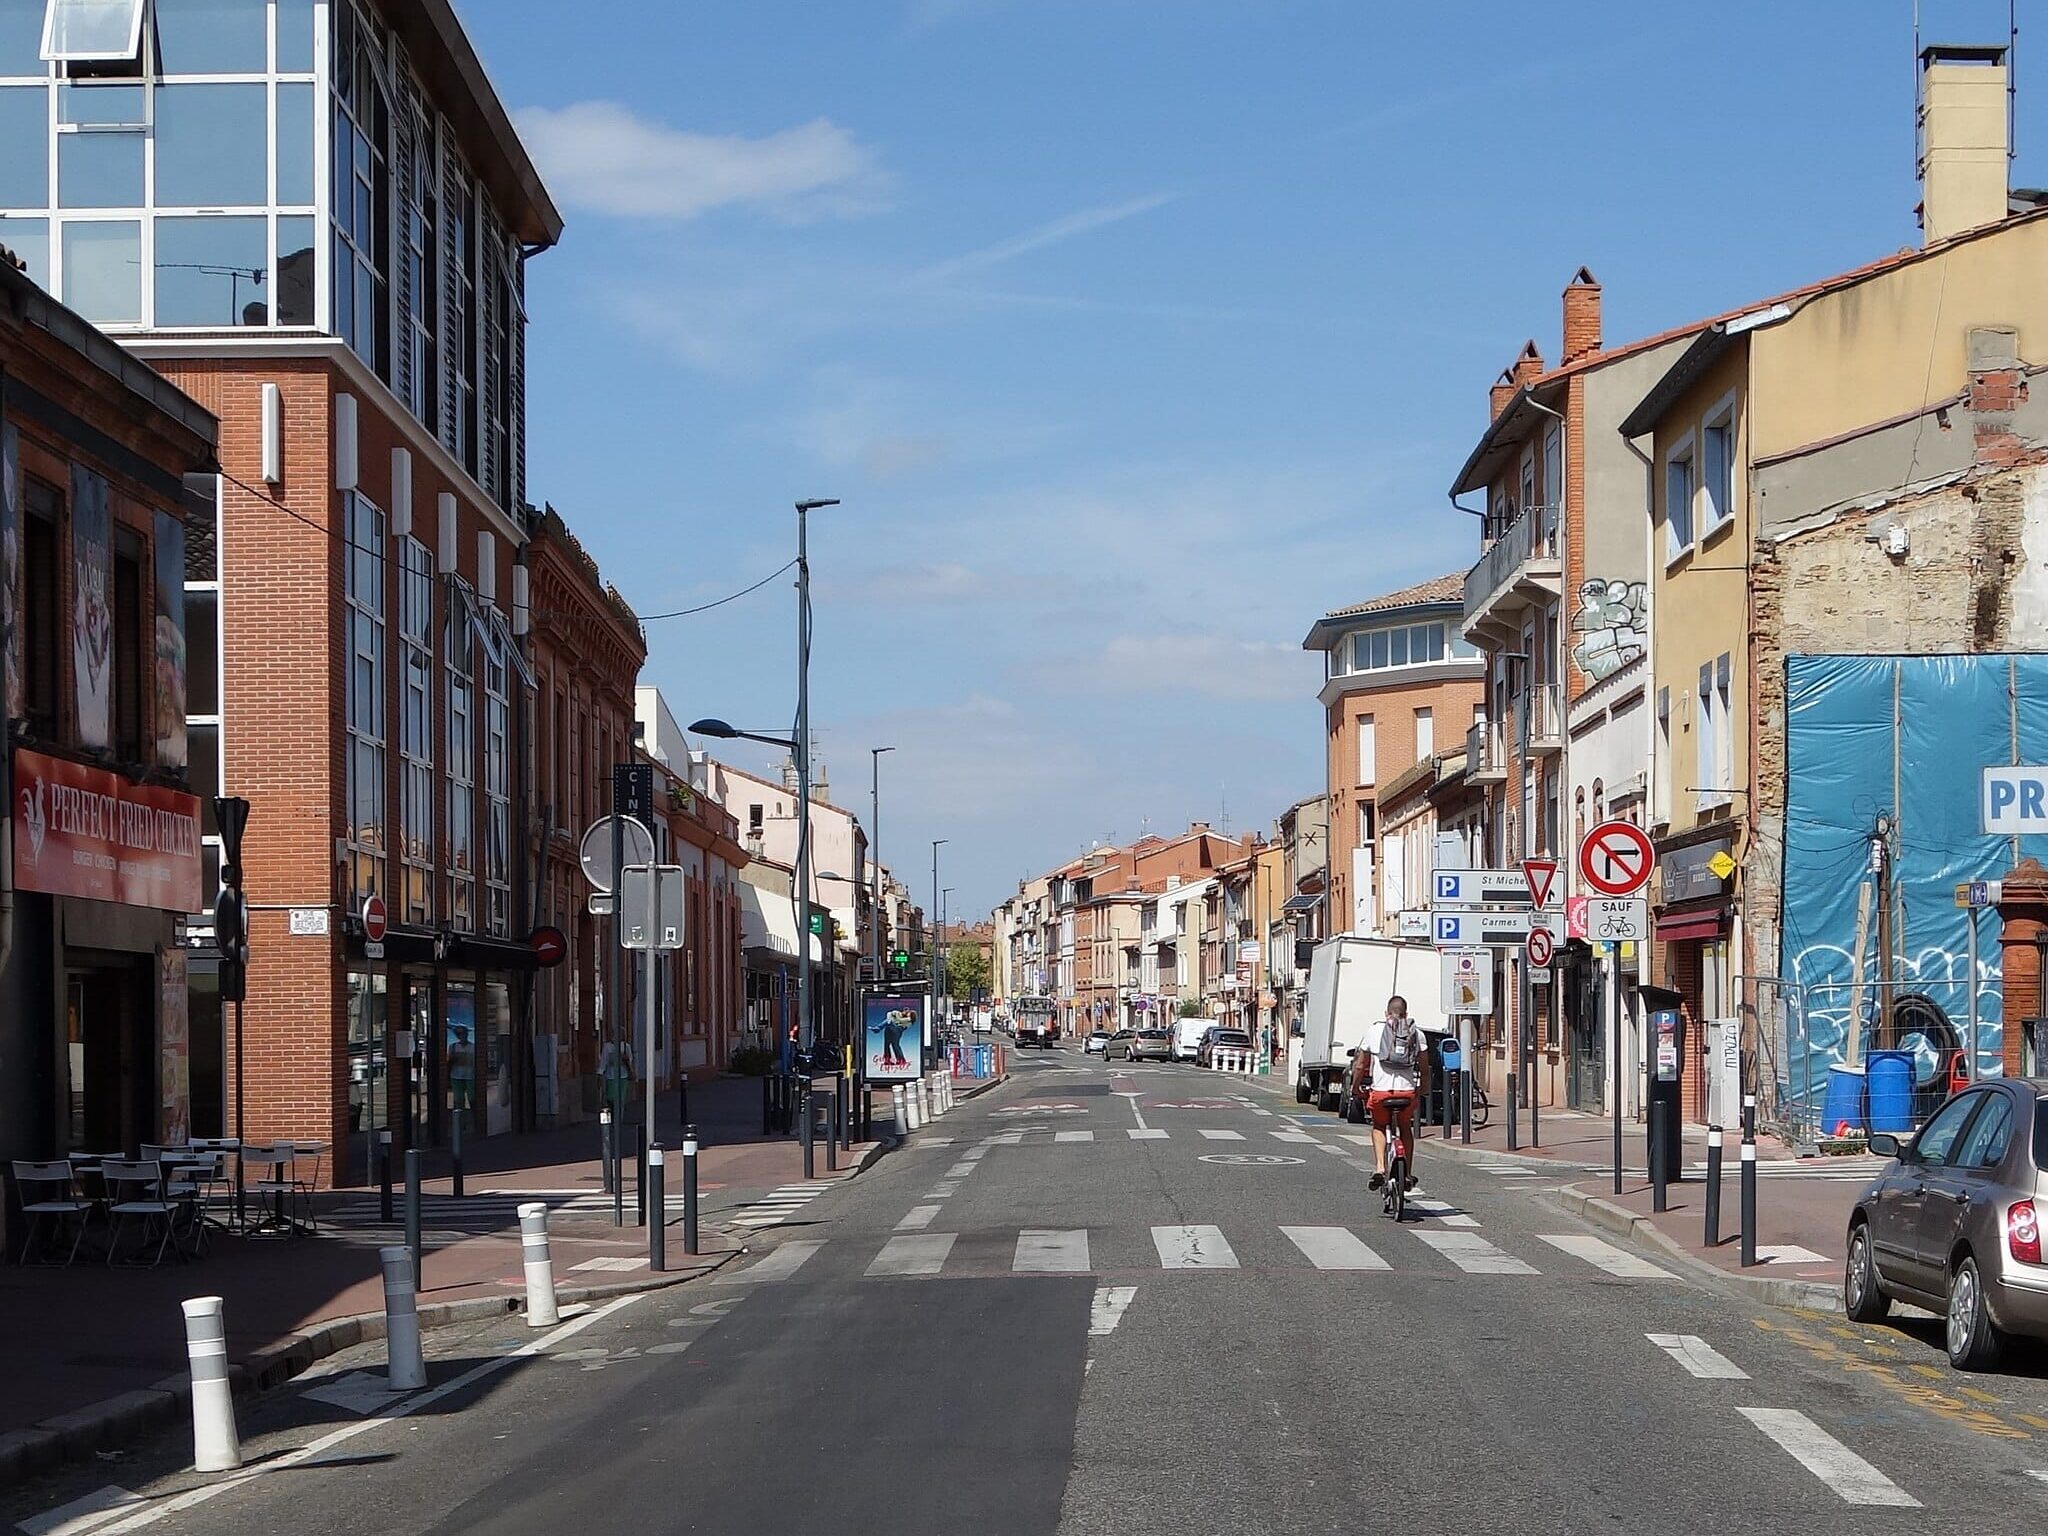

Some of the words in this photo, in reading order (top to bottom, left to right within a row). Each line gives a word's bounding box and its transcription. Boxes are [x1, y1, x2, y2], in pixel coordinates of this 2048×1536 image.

[51, 783, 117, 841] PERFECT
[119, 799, 152, 850] FRIED
[154, 808, 197, 858] CHICKEN
[1441, 877, 1456, 896] P
[1481, 876, 1492, 885] St
[1601, 902, 1633, 912] SAUF
[1481, 918, 1518, 926] Carmes
[1441, 919, 1456, 938] P
[1661, 1012, 1670, 1024] P
